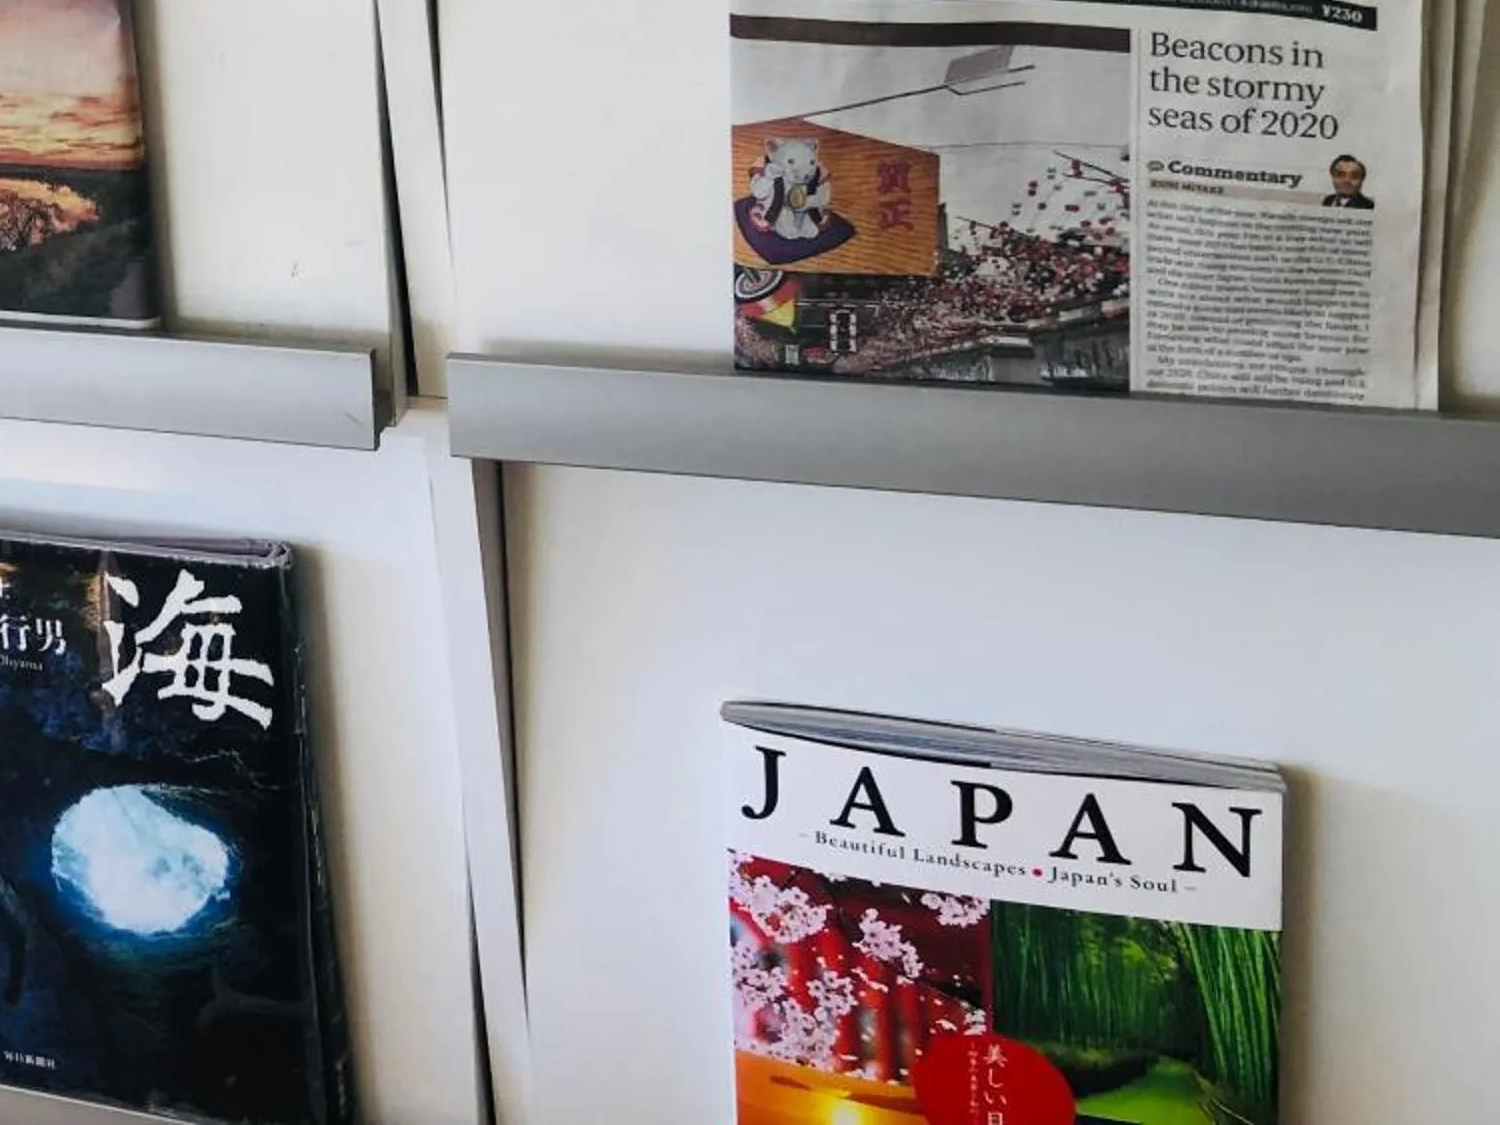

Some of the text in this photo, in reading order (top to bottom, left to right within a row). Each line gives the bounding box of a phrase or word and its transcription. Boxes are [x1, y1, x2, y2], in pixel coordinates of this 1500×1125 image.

[1150, 31, 1324, 68] Beacons in
[1150, 66, 1326, 110] the stormy
[1148, 106, 1340, 140] seas of 2020
[1167, 159, 1303, 190] Commentary
[102, 567, 274, 732] 海
[741, 744, 1263, 879] JAPAN
[814, 830, 1179, 895] Beautiful Landscapes Japan's Soul
